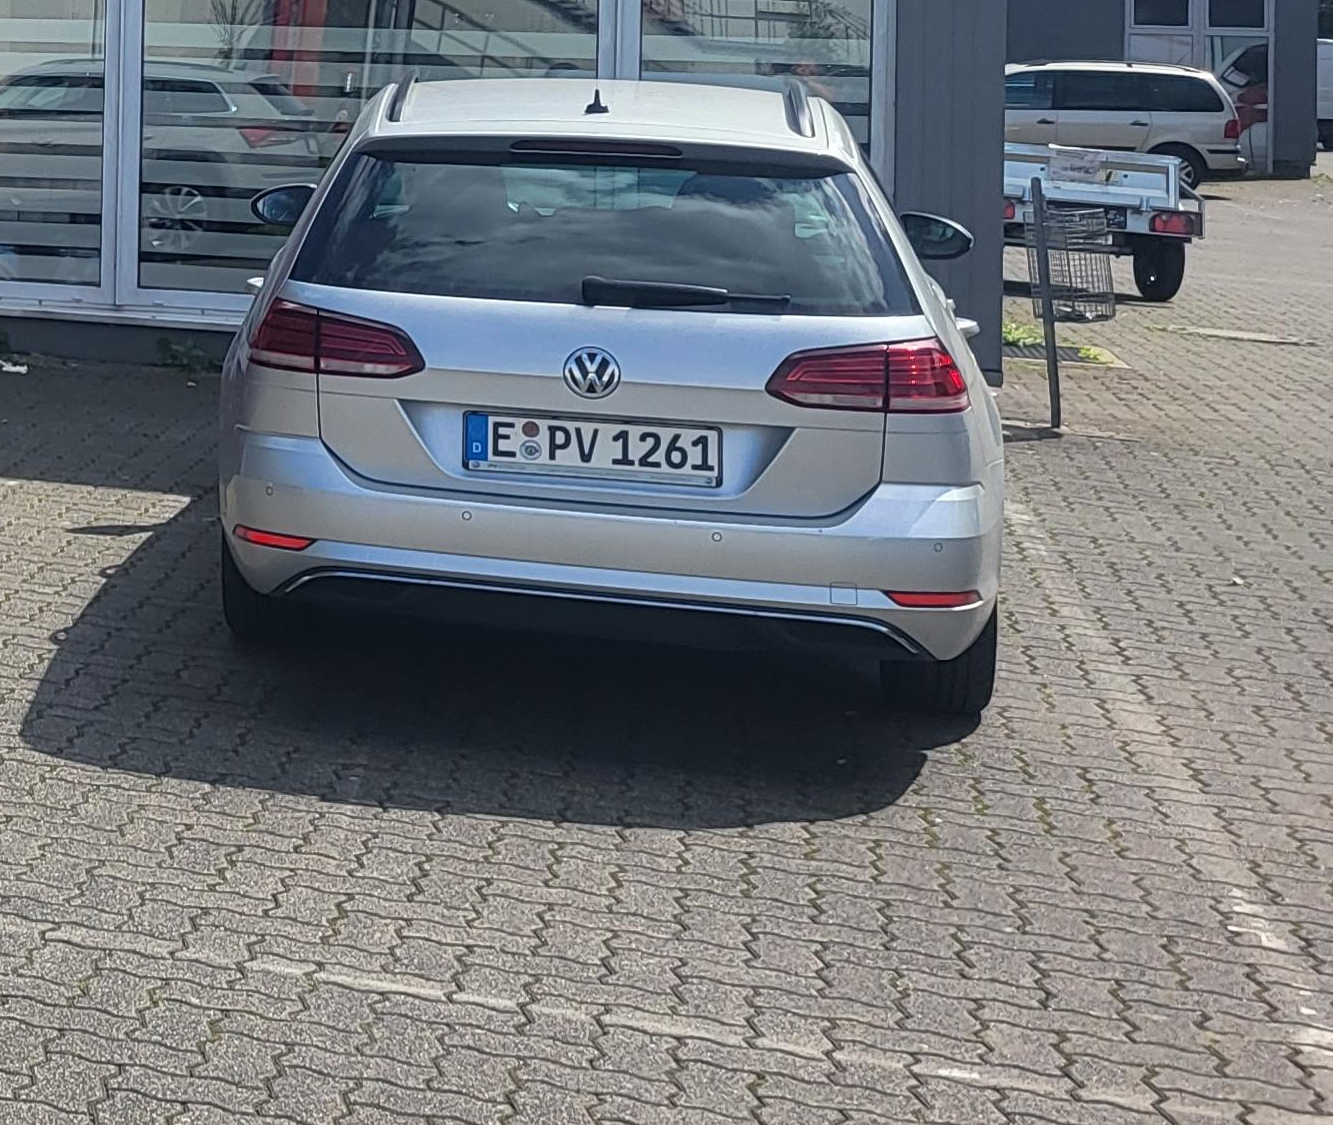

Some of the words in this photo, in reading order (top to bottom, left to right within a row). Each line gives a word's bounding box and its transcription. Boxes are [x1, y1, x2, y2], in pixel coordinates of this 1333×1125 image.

[491, 421, 517, 458] E
[547, 425, 600, 464] PV
[611, 429, 716, 472] 1261
